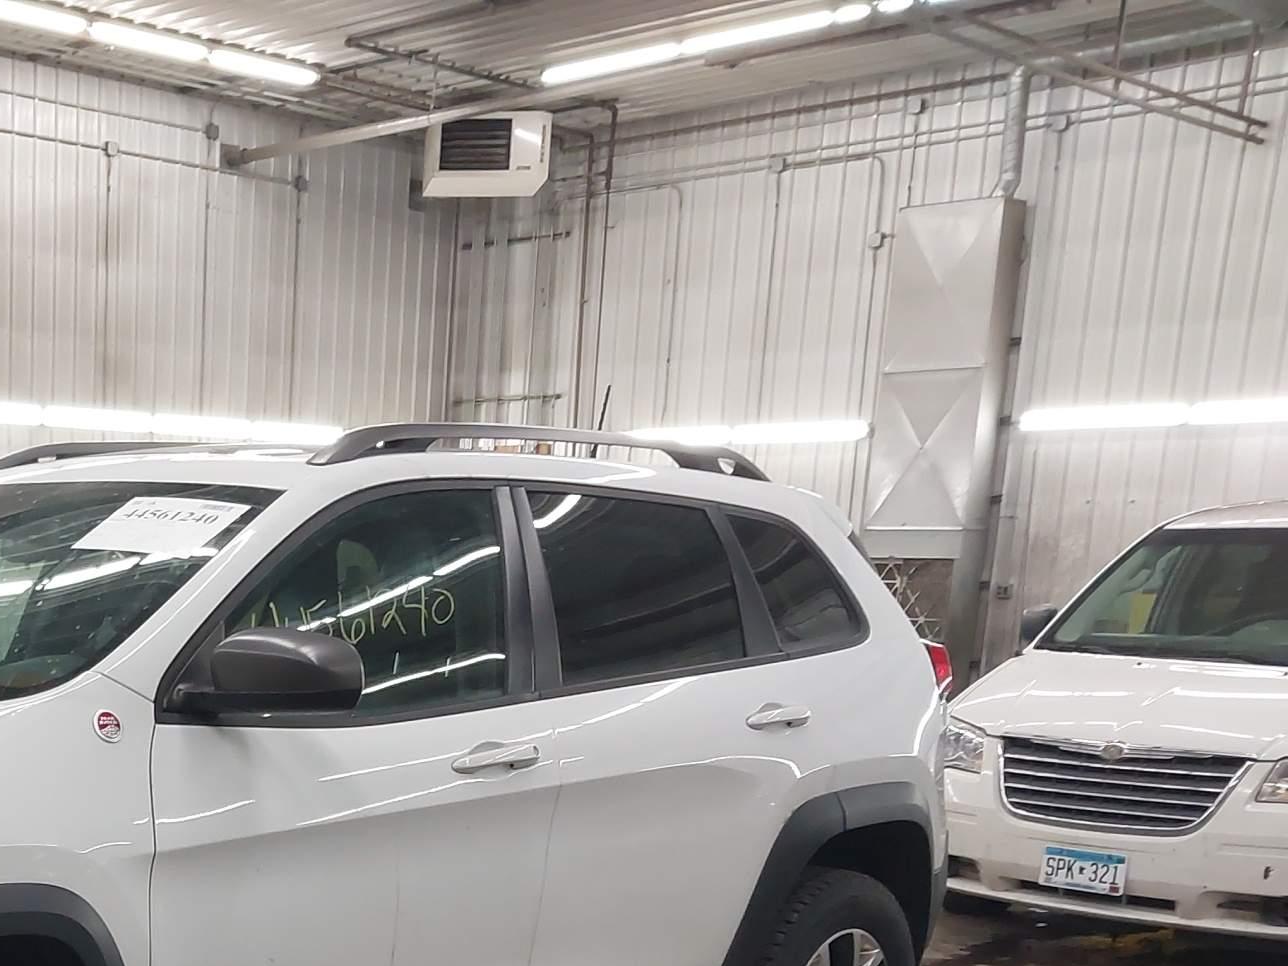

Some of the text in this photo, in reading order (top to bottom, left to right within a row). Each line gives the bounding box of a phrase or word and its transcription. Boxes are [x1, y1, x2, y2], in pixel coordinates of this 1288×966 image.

[122, 508, 220, 525] 44561240
[1045, 856, 1119, 885] SPK 321
